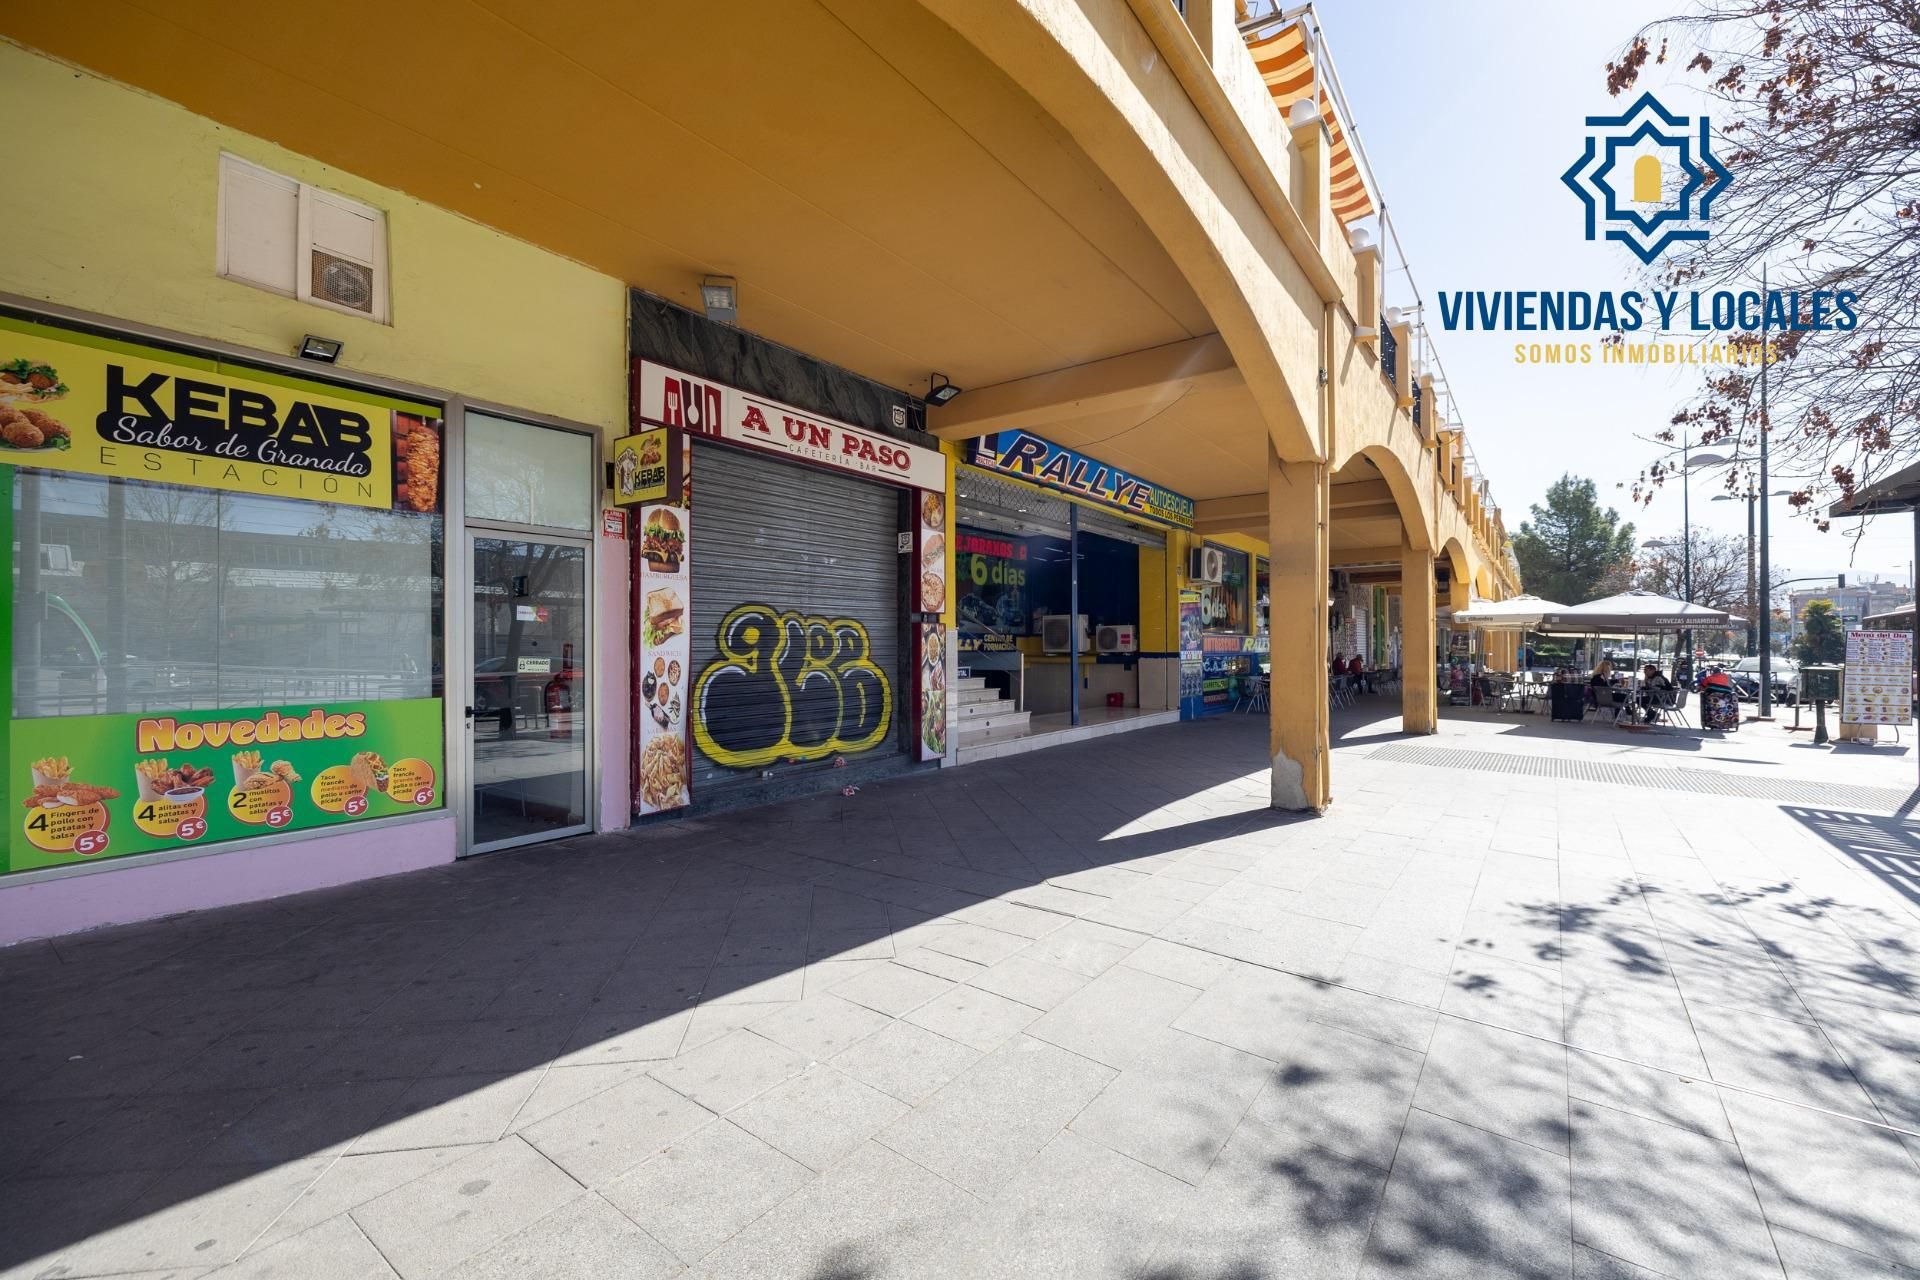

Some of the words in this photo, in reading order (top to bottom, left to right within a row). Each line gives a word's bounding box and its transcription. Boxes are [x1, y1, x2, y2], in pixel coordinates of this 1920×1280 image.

[106, 363, 372, 456] KEBAB
[112, 415, 208, 452] Sabor
[214, 433, 250, 459] de
[256, 438, 368, 476] Granada
[741, 405, 771, 435] A
[782, 416, 832, 451] UN
[841, 433, 912, 471] PASO
[99, 446, 372, 499] ESTACIÓN
[634, 466, 666, 488] KEBAB
[997, 433, 1152, 512] RALLYE
[1149, 486, 1194, 518] AUTOESCUELA
[971, 553, 988, 586] 6
[991, 560, 1025, 586] días
[1202, 587, 1212, 625] 6
[137, 709, 367, 753] Novedades
[233, 792, 247, 808] 2
[249, 788, 281, 797] muslitos
[50, 809, 87, 819] Fingers
[137, 804, 156, 822] 4
[158, 803, 182, 811] alitas
[249, 801, 277, 809] patatas
[27, 813, 48, 832] 4
[50, 818, 75, 827] pollo
[158, 810, 190, 819] patatas
[50, 824, 86, 834] patatas
[50, 833, 75, 841] salsa
[79, 834, 106, 851] 5€
